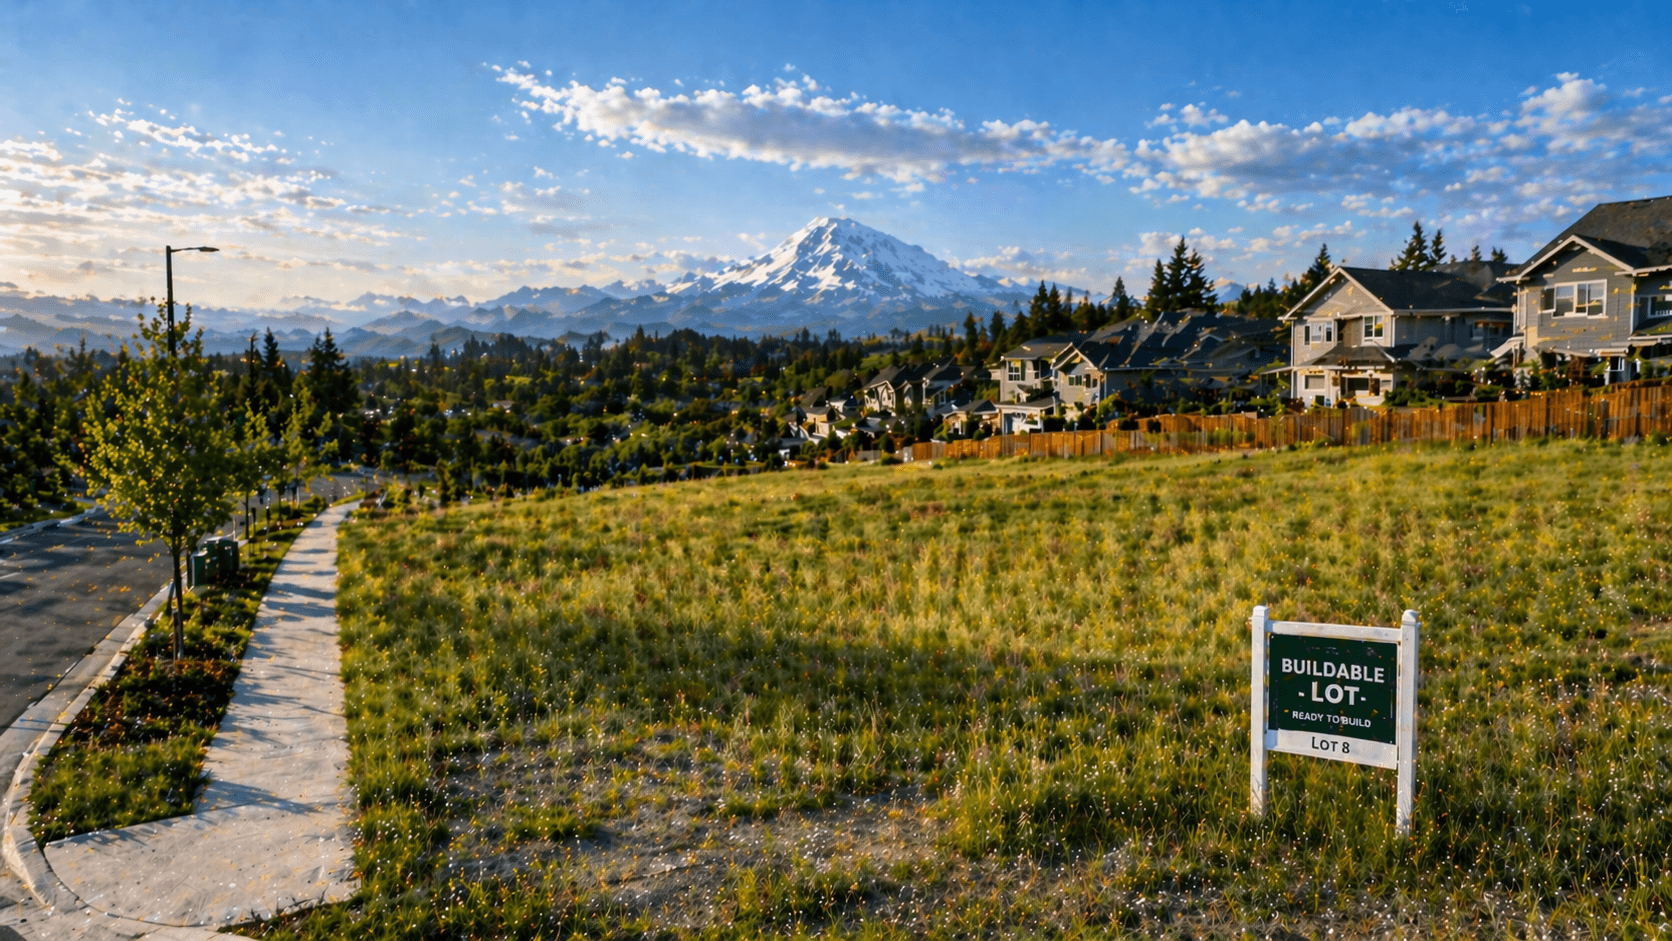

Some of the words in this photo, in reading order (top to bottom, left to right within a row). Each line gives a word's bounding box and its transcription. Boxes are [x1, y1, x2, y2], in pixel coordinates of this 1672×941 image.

[1281, 657, 1385, 684] BUILDABLE
[1292, 710, 1324, 722] READY
[1326, 714, 1340, 724] TO
[1341, 716, 1372, 728] BUILD
[1341, 741, 1350, 754] 8
